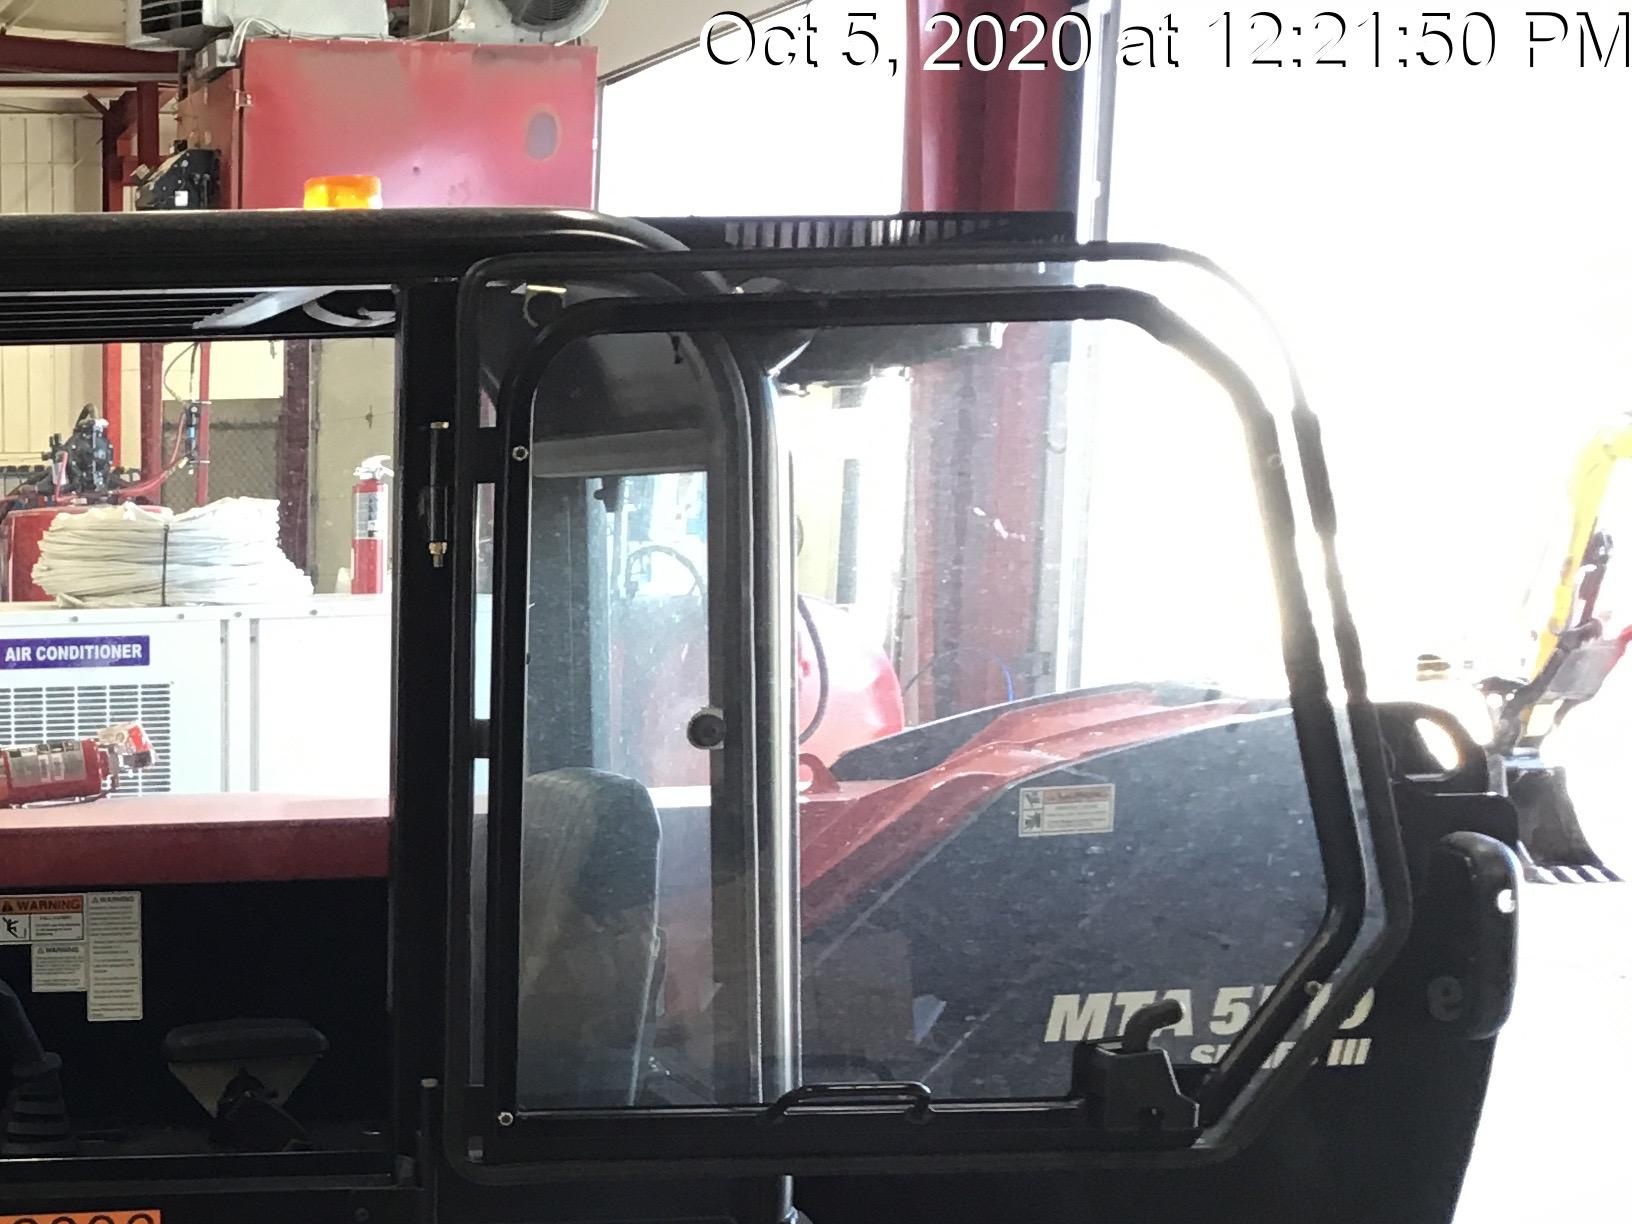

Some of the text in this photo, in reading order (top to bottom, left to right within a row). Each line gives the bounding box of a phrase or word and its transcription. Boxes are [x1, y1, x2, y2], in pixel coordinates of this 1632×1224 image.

[4, 643, 143, 662] AIR CONDITIONER
[16, 899, 81, 912] WARNING
